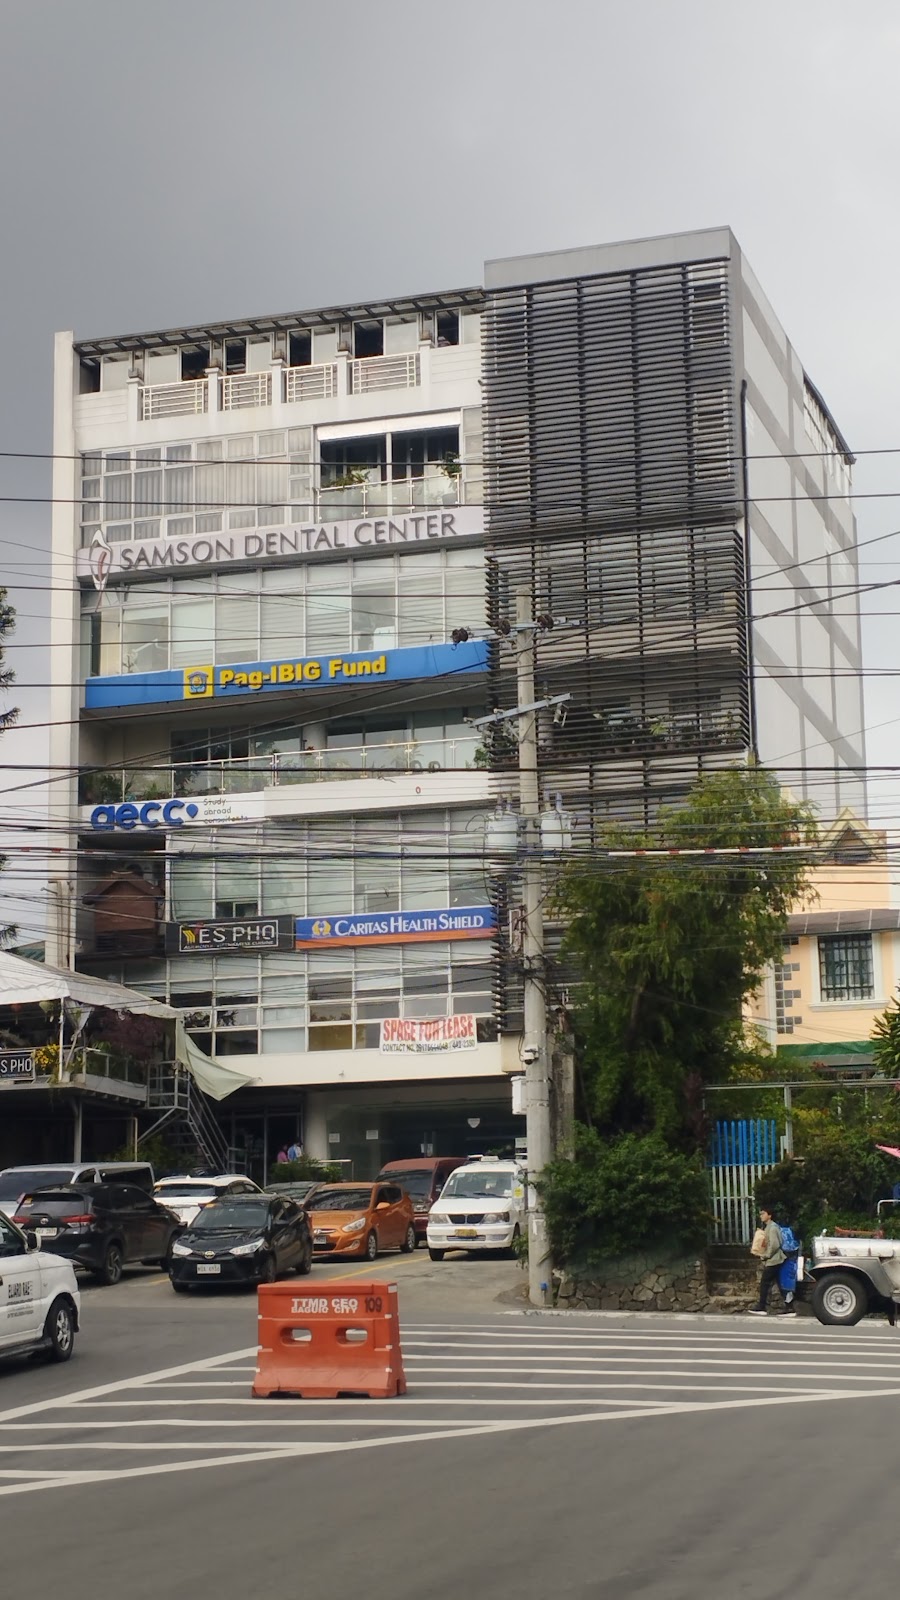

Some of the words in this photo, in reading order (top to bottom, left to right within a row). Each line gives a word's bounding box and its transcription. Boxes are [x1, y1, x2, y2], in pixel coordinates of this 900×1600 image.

[120, 537, 234, 570] SAMSON
[244, 525, 346, 558] DENTAL
[353, 513, 457, 546] CENTER
[219, 661, 322, 690] Pag-IBIG
[328, 655, 387, 679] Fund
[203, 797, 227, 807] Study
[91, 799, 185, 831] aecc
[203, 806, 232, 816] abroad
[334, 919, 389, 937] CARITAS
[390, 916, 438, 933] HEALTH
[439, 913, 484, 930] SHIELD
[383, 1019, 416, 1042] SPACE
[418, 1020, 441, 1042] FOR
[443, 1014, 474, 1040] LEASE
[382, 1043, 406, 1052] CONTACT
[10, 1058, 32, 1072] PHO
[333, 1306, 358, 1314] CITY
[364, 1297, 383, 1313] 109
